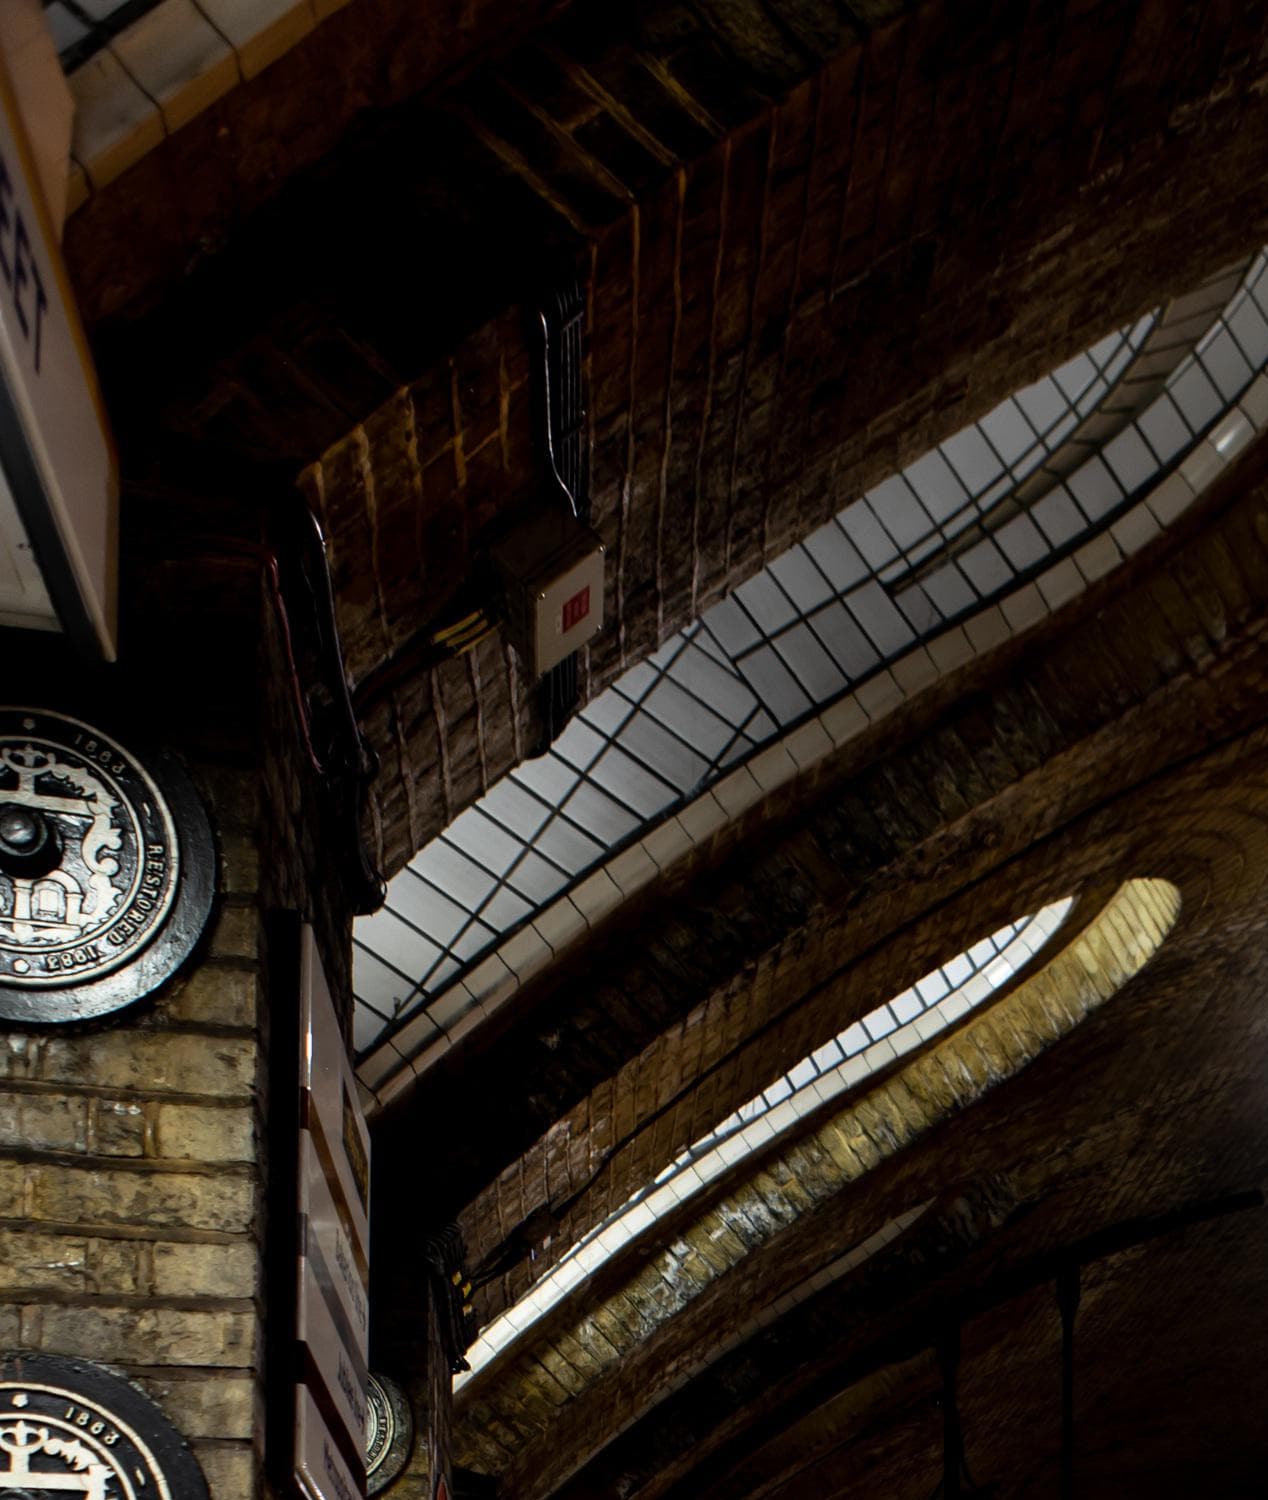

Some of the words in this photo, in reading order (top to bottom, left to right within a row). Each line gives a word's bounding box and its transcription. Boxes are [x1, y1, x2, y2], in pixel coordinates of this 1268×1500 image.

[106, 844, 165, 946] RESTORED
[46, 944, 98, 971] 1983
[64, 1406, 120, 1445] 1863
